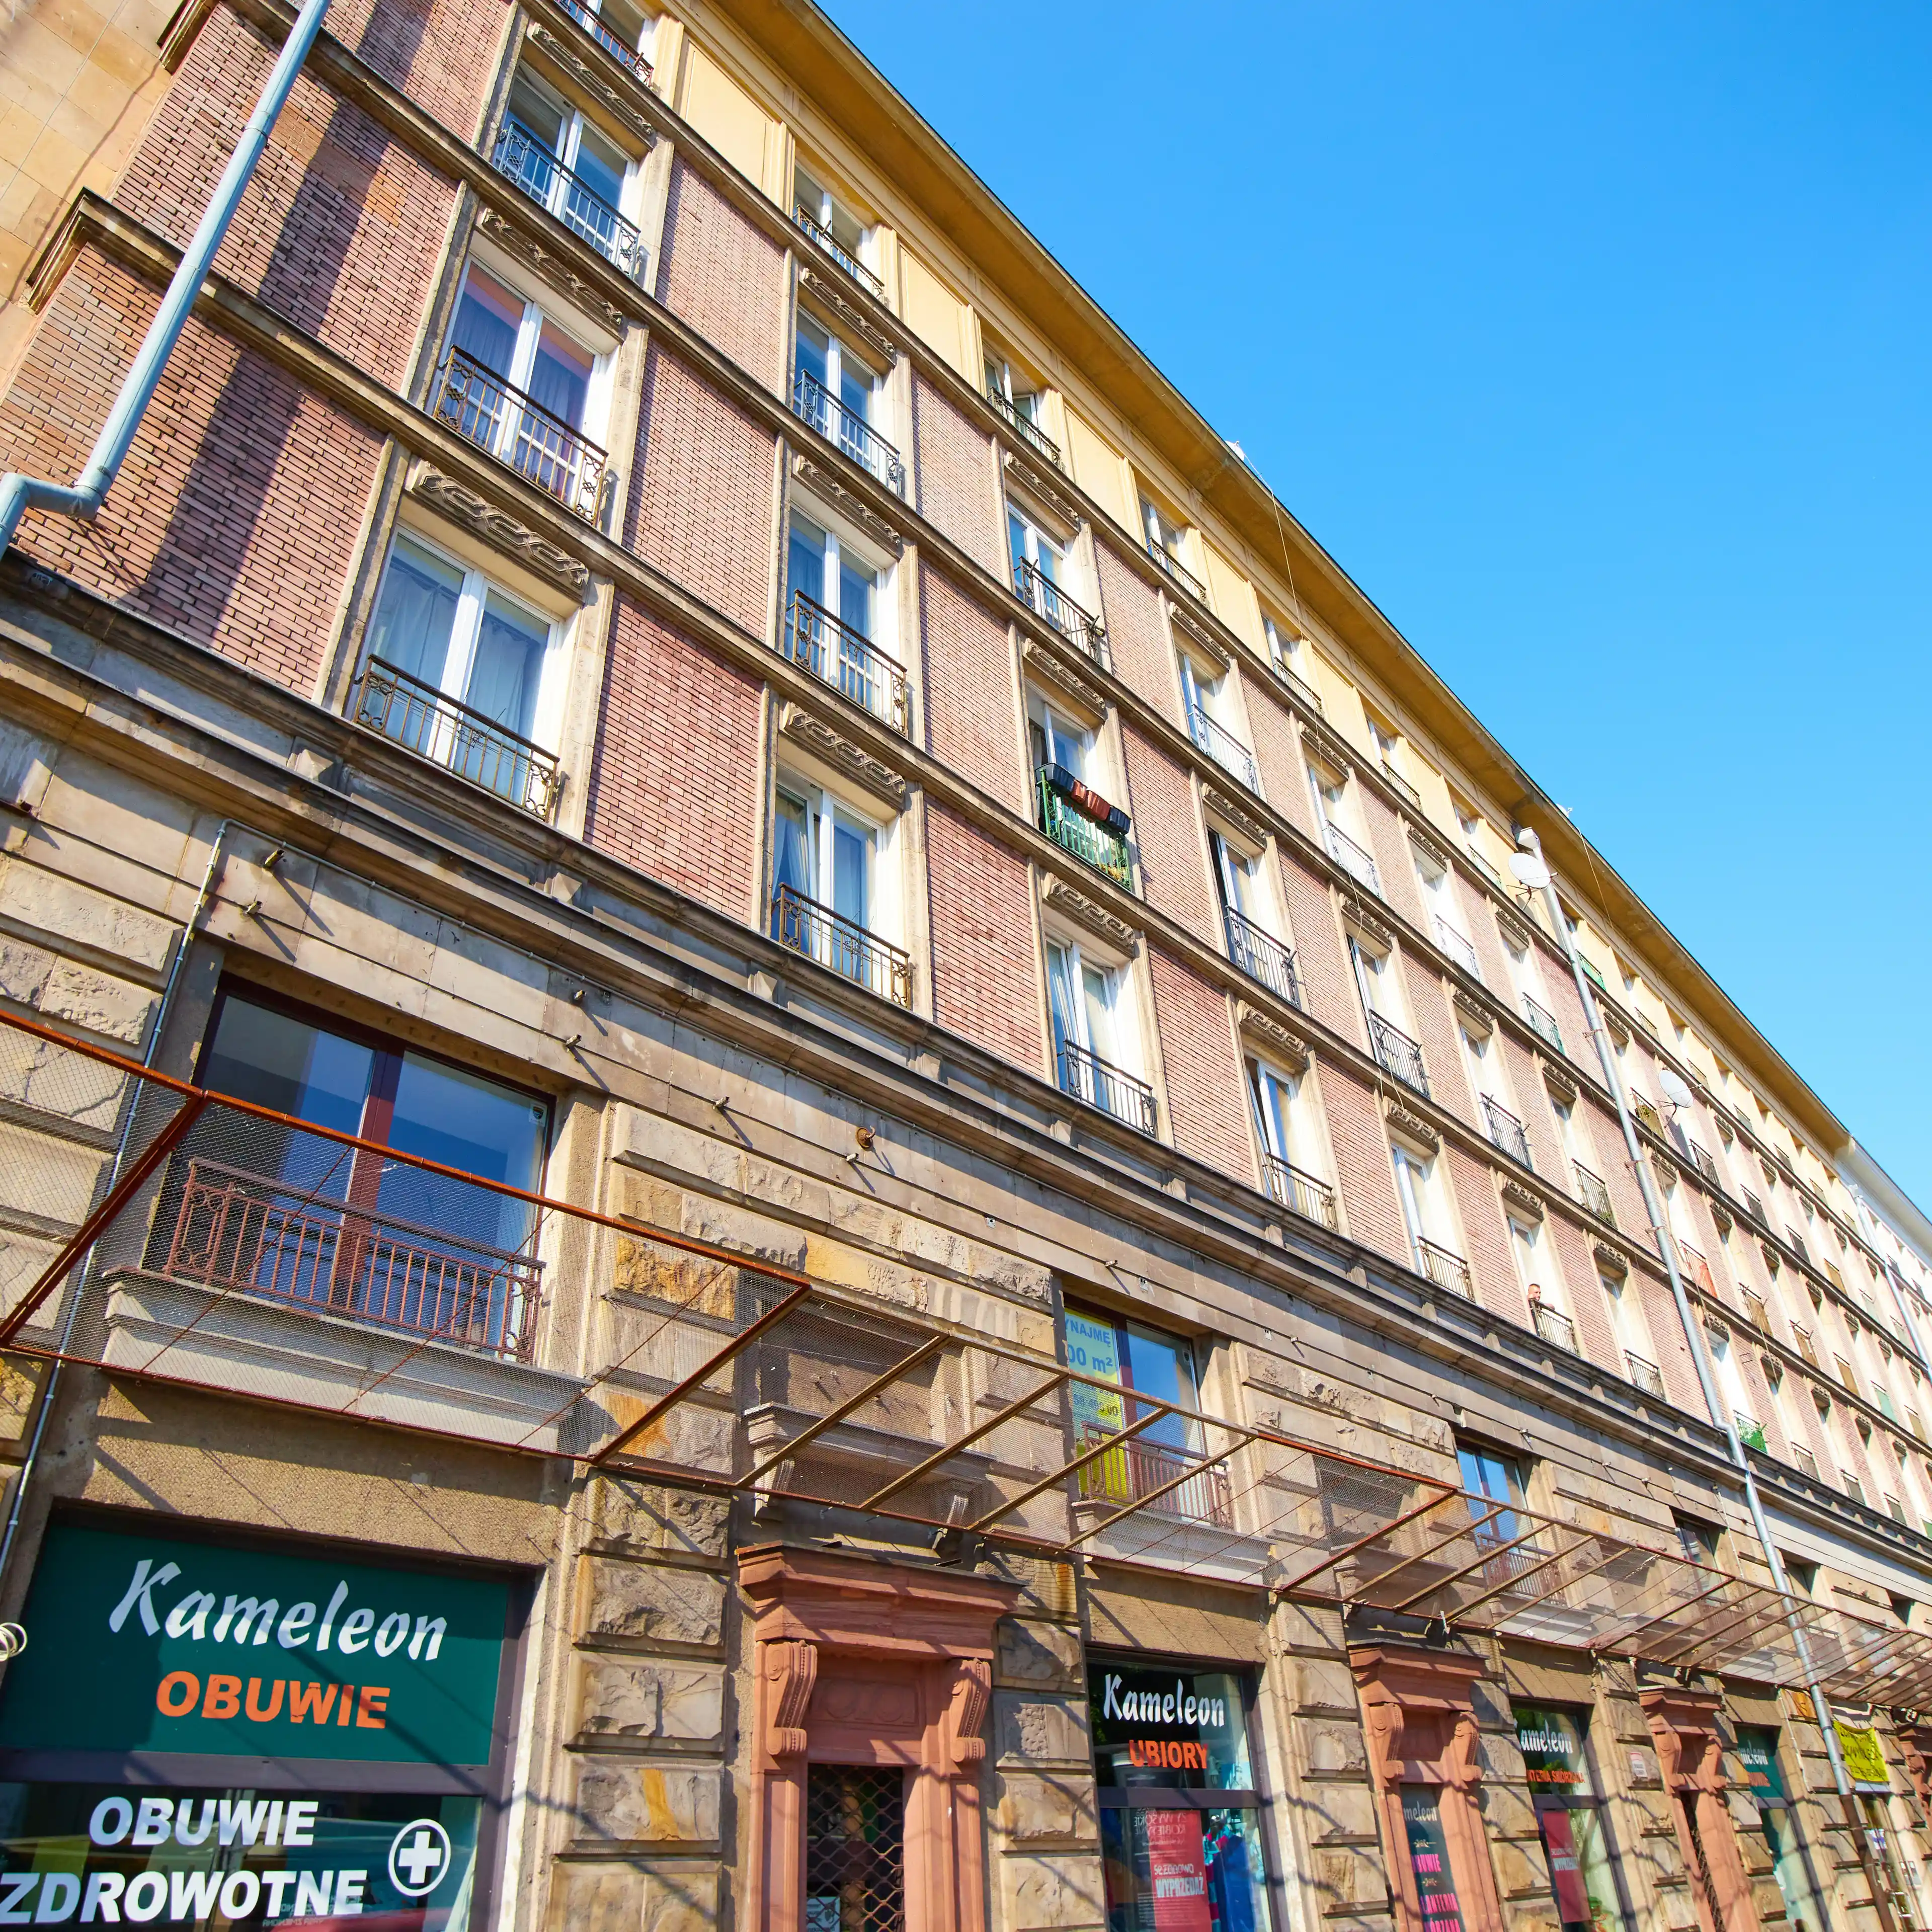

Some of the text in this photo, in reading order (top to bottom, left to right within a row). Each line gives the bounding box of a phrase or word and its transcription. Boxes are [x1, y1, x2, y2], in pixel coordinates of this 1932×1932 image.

[109, 1560, 447, 1661] Kameleon
[156, 1671, 390, 1729] OBUWIE
[1103, 1673, 1225, 1727] Kameleon
[1129, 1739, 1208, 1769] UBIORY
[1514, 1718, 1573, 1753] ameleon
[89, 1797, 319, 1847] OBUWIE
[0, 1870, 368, 1924] ZDROWOTNE
[1155, 1872, 1205, 1898] WYPRZEDAŻ
